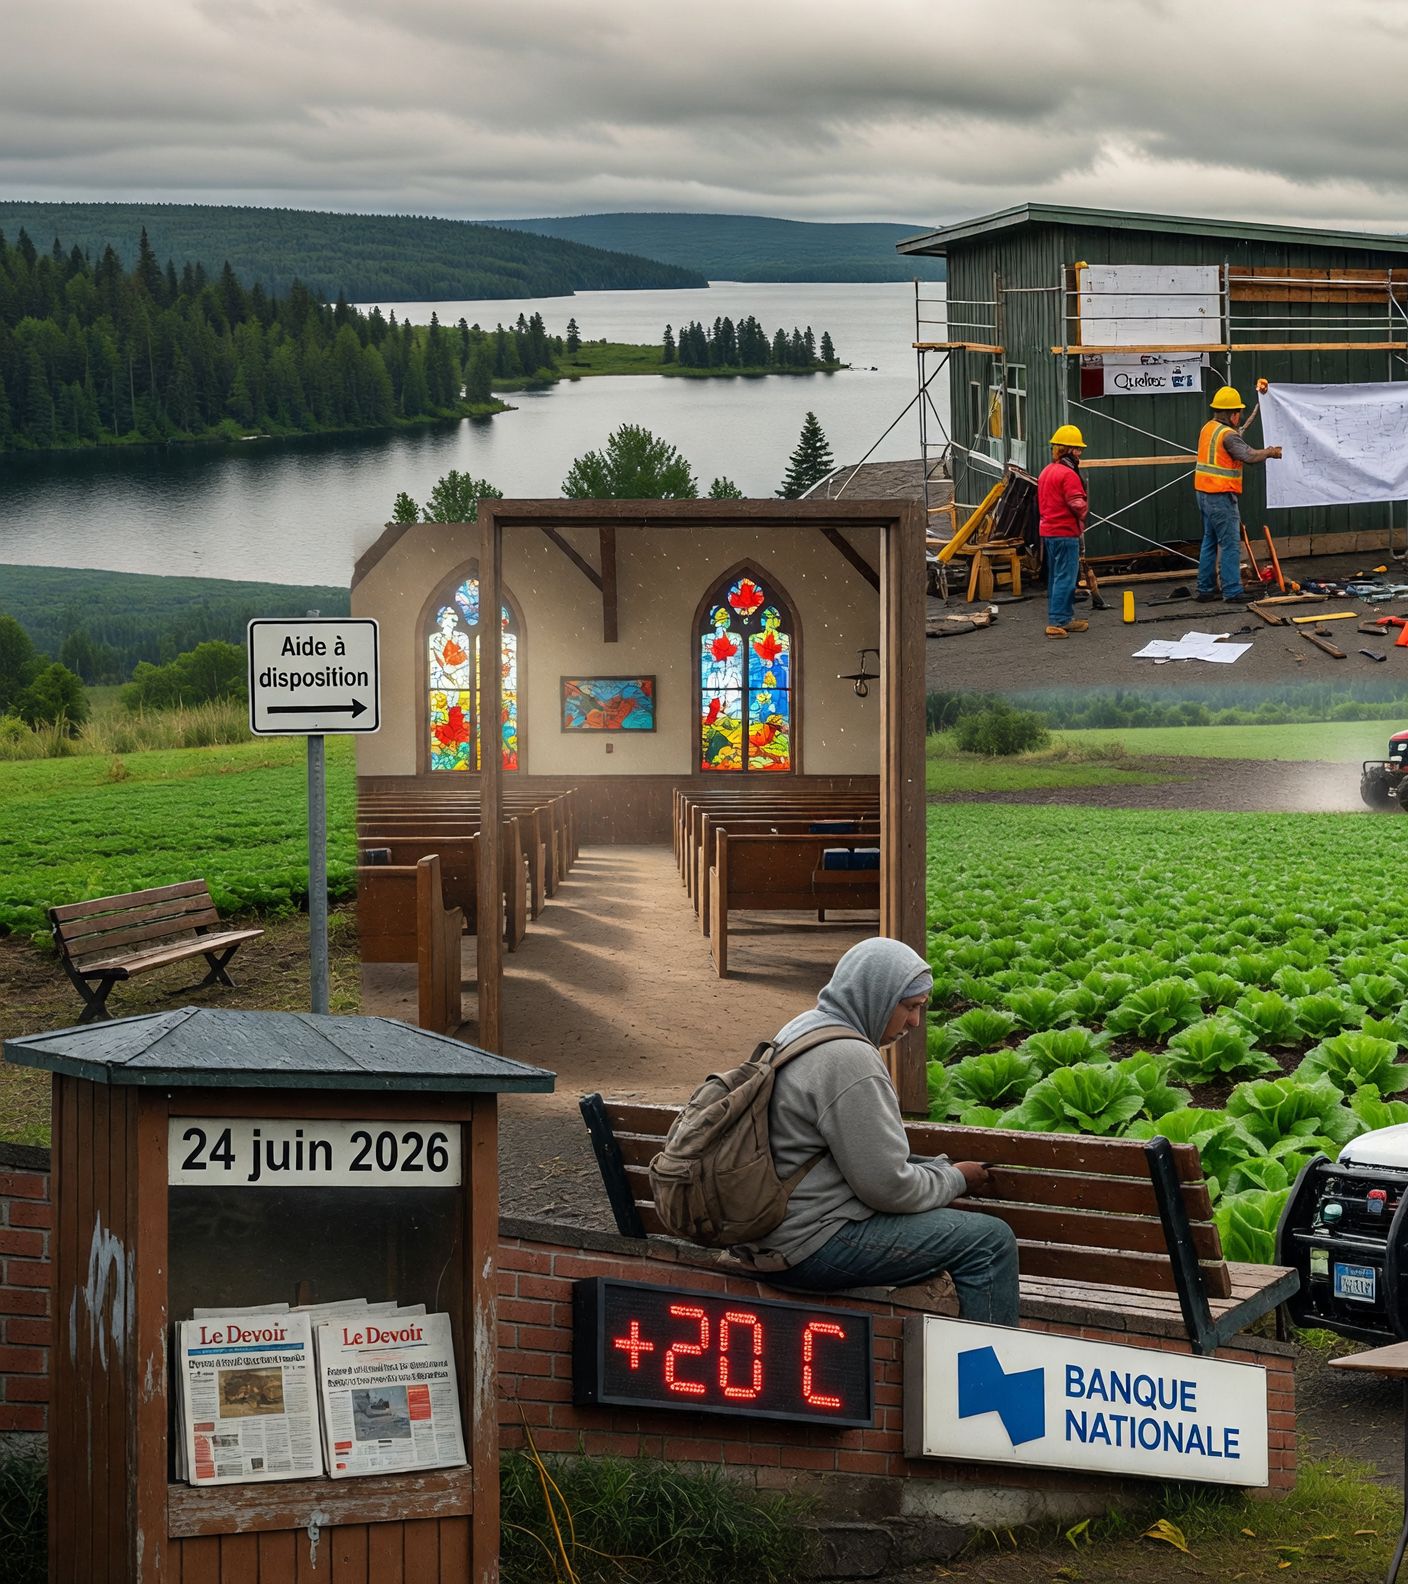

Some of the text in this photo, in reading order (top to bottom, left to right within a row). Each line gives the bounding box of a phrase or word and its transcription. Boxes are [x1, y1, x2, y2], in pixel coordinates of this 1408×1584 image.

[281, 635, 346, 656] Aide à
[259, 666, 369, 692] disposition
[181, 1127, 449, 1182] 24 juin 2026
[200, 1322, 288, 1345] Le Devoir
[342, 1323, 423, 1346] Le Devoir
[803, 1321, 846, 1408] C
[1065, 1364, 1197, 1412] BANQUE
[1065, 1409, 1240, 1460] NATIONALE
